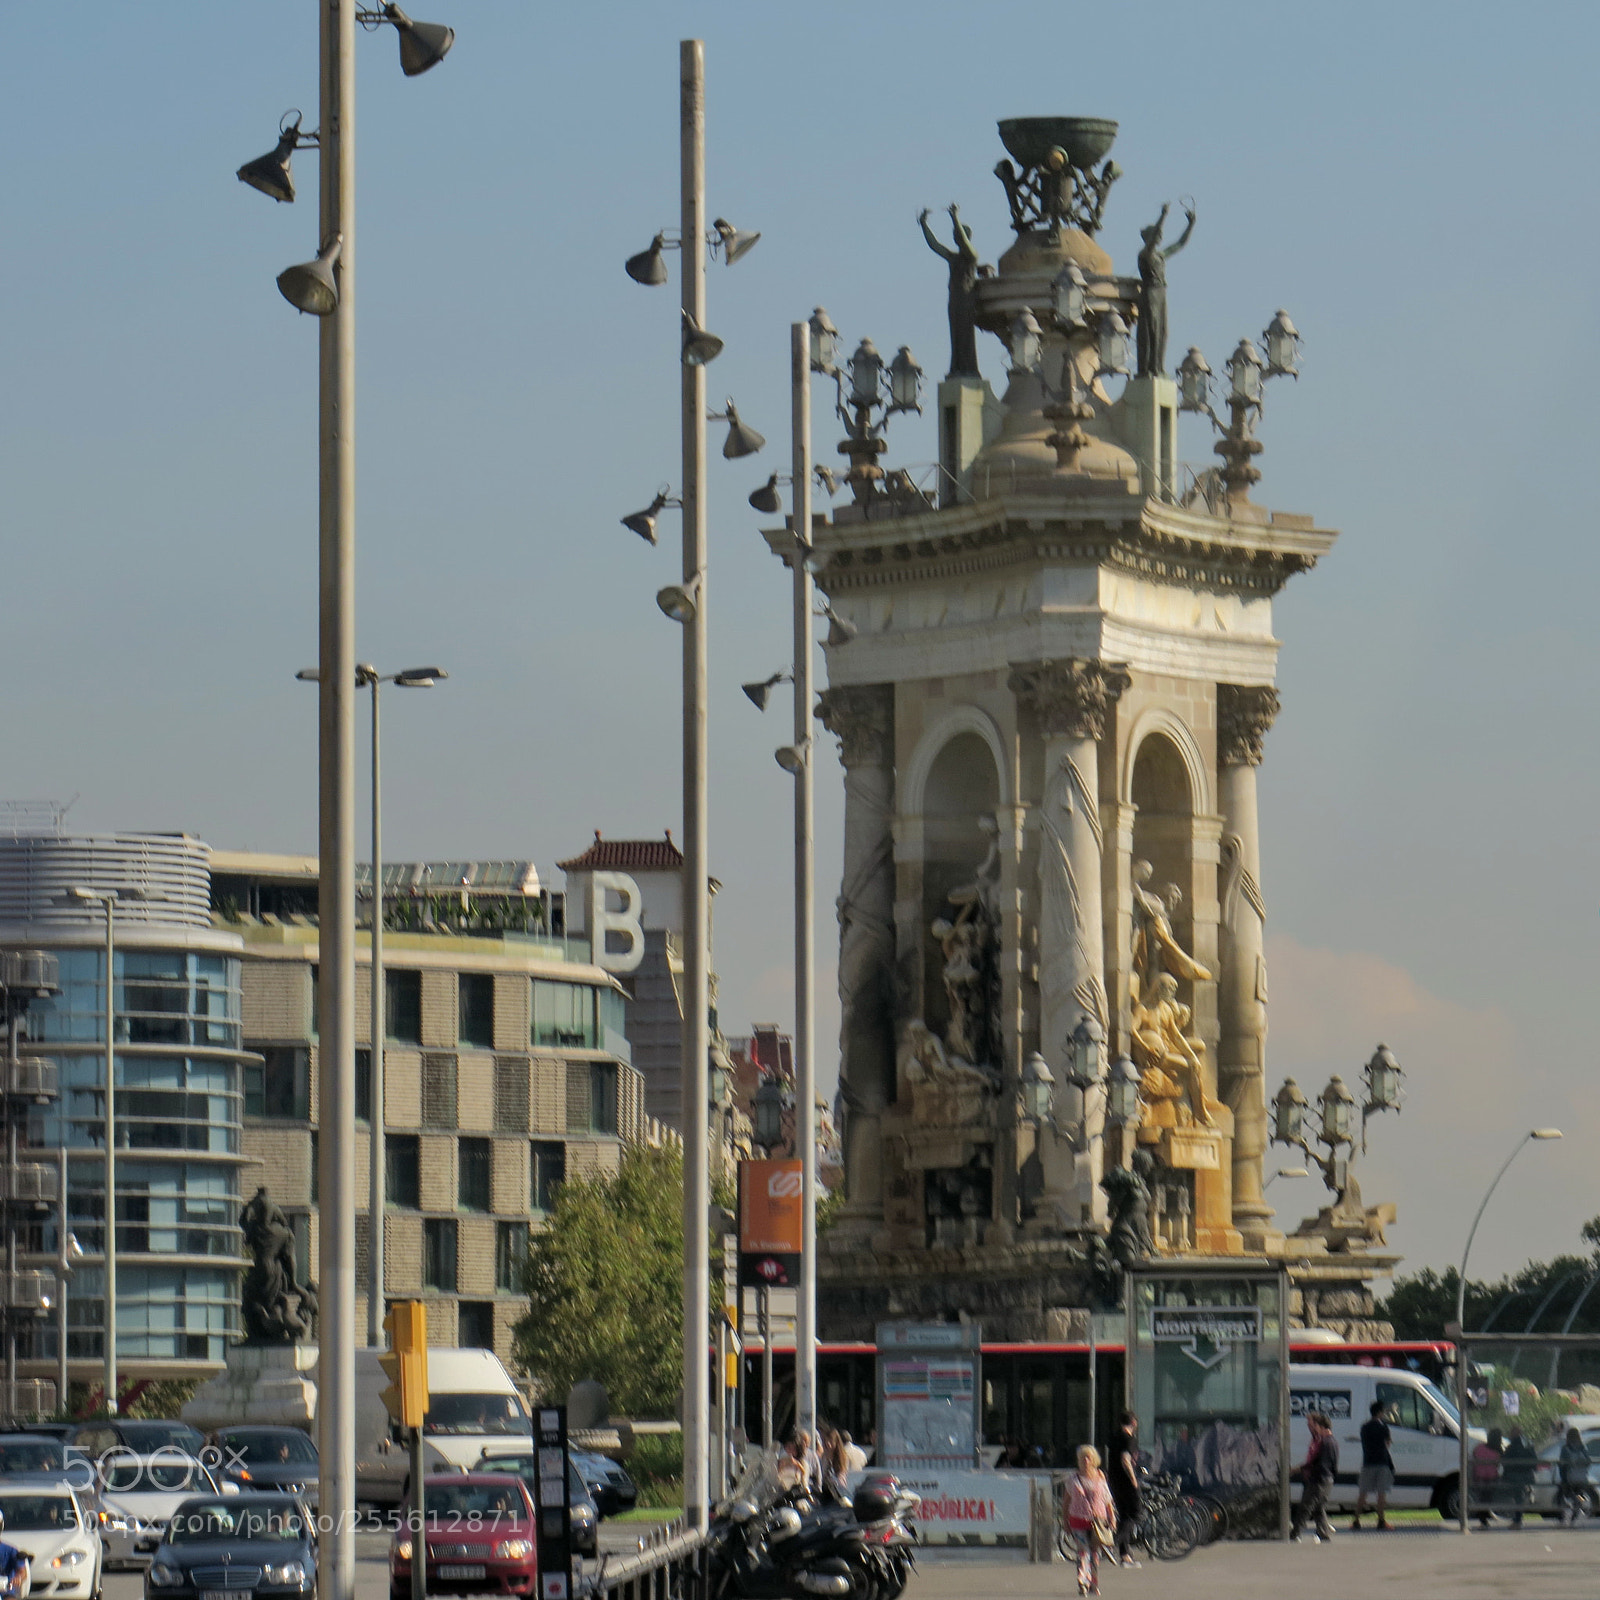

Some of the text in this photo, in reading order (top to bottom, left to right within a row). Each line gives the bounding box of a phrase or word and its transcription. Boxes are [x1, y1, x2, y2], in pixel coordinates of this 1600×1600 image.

[592, 870, 645, 972] B
[763, 1262, 777, 1276] M
[1155, 1320, 1256, 1335] MONTSERRAT
